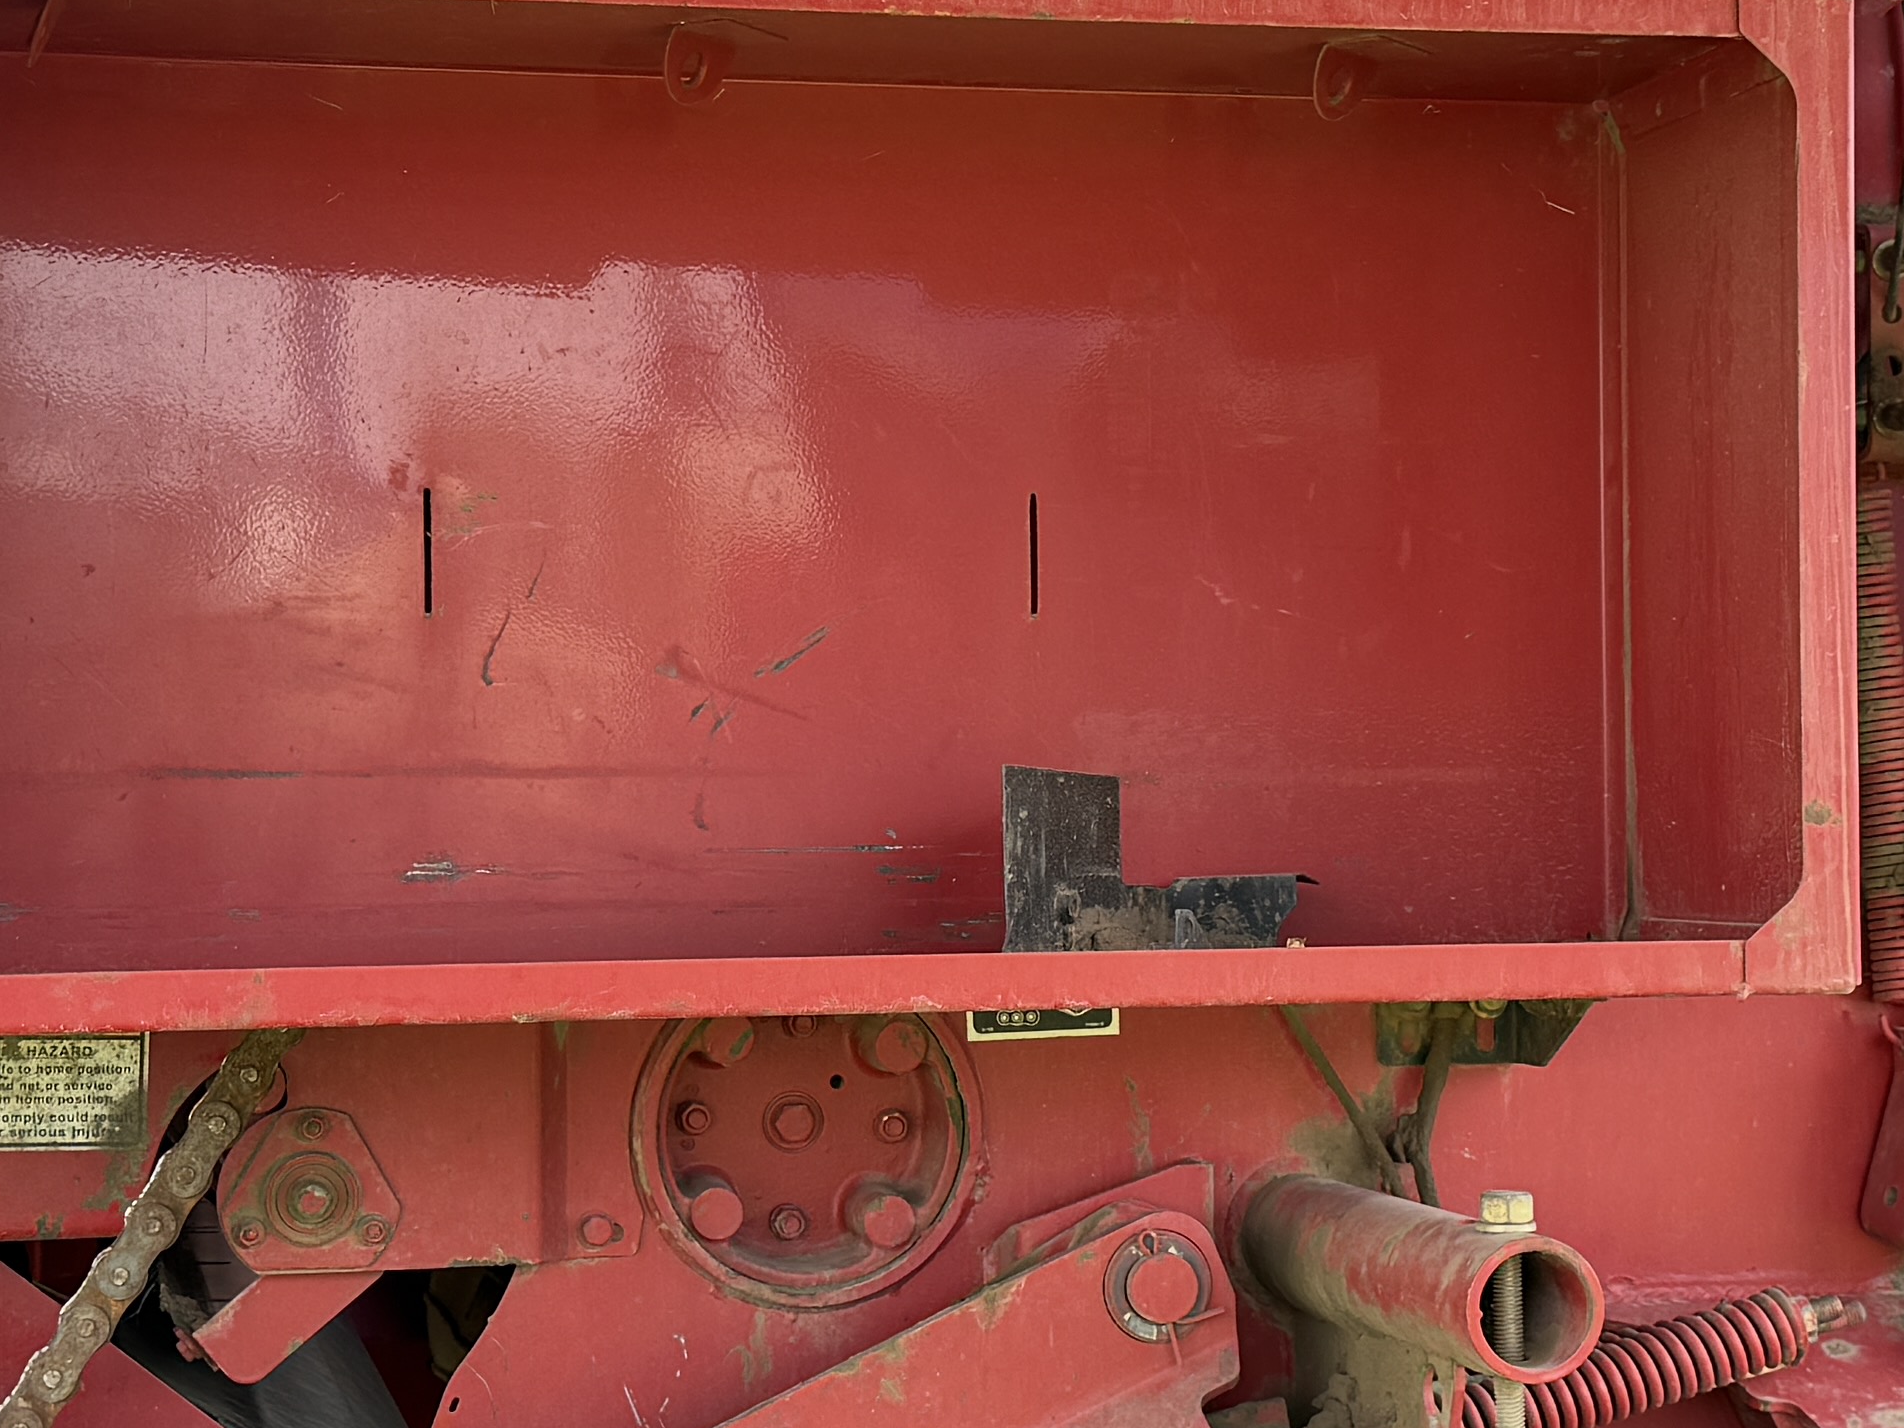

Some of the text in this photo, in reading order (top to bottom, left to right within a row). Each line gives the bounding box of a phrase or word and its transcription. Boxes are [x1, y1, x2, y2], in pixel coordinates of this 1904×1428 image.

[27, 1045, 94, 1057] HAZARD
[18, 1065, 31, 1074] to
[36, 1064, 73, 1075] home
[64, 1081, 112, 1091] service
[0, 1095, 10, 1104] in
[16, 1095, 52, 1104] home
[50, 1111, 88, 1122] could
[10, 1126, 66, 1138] serious
